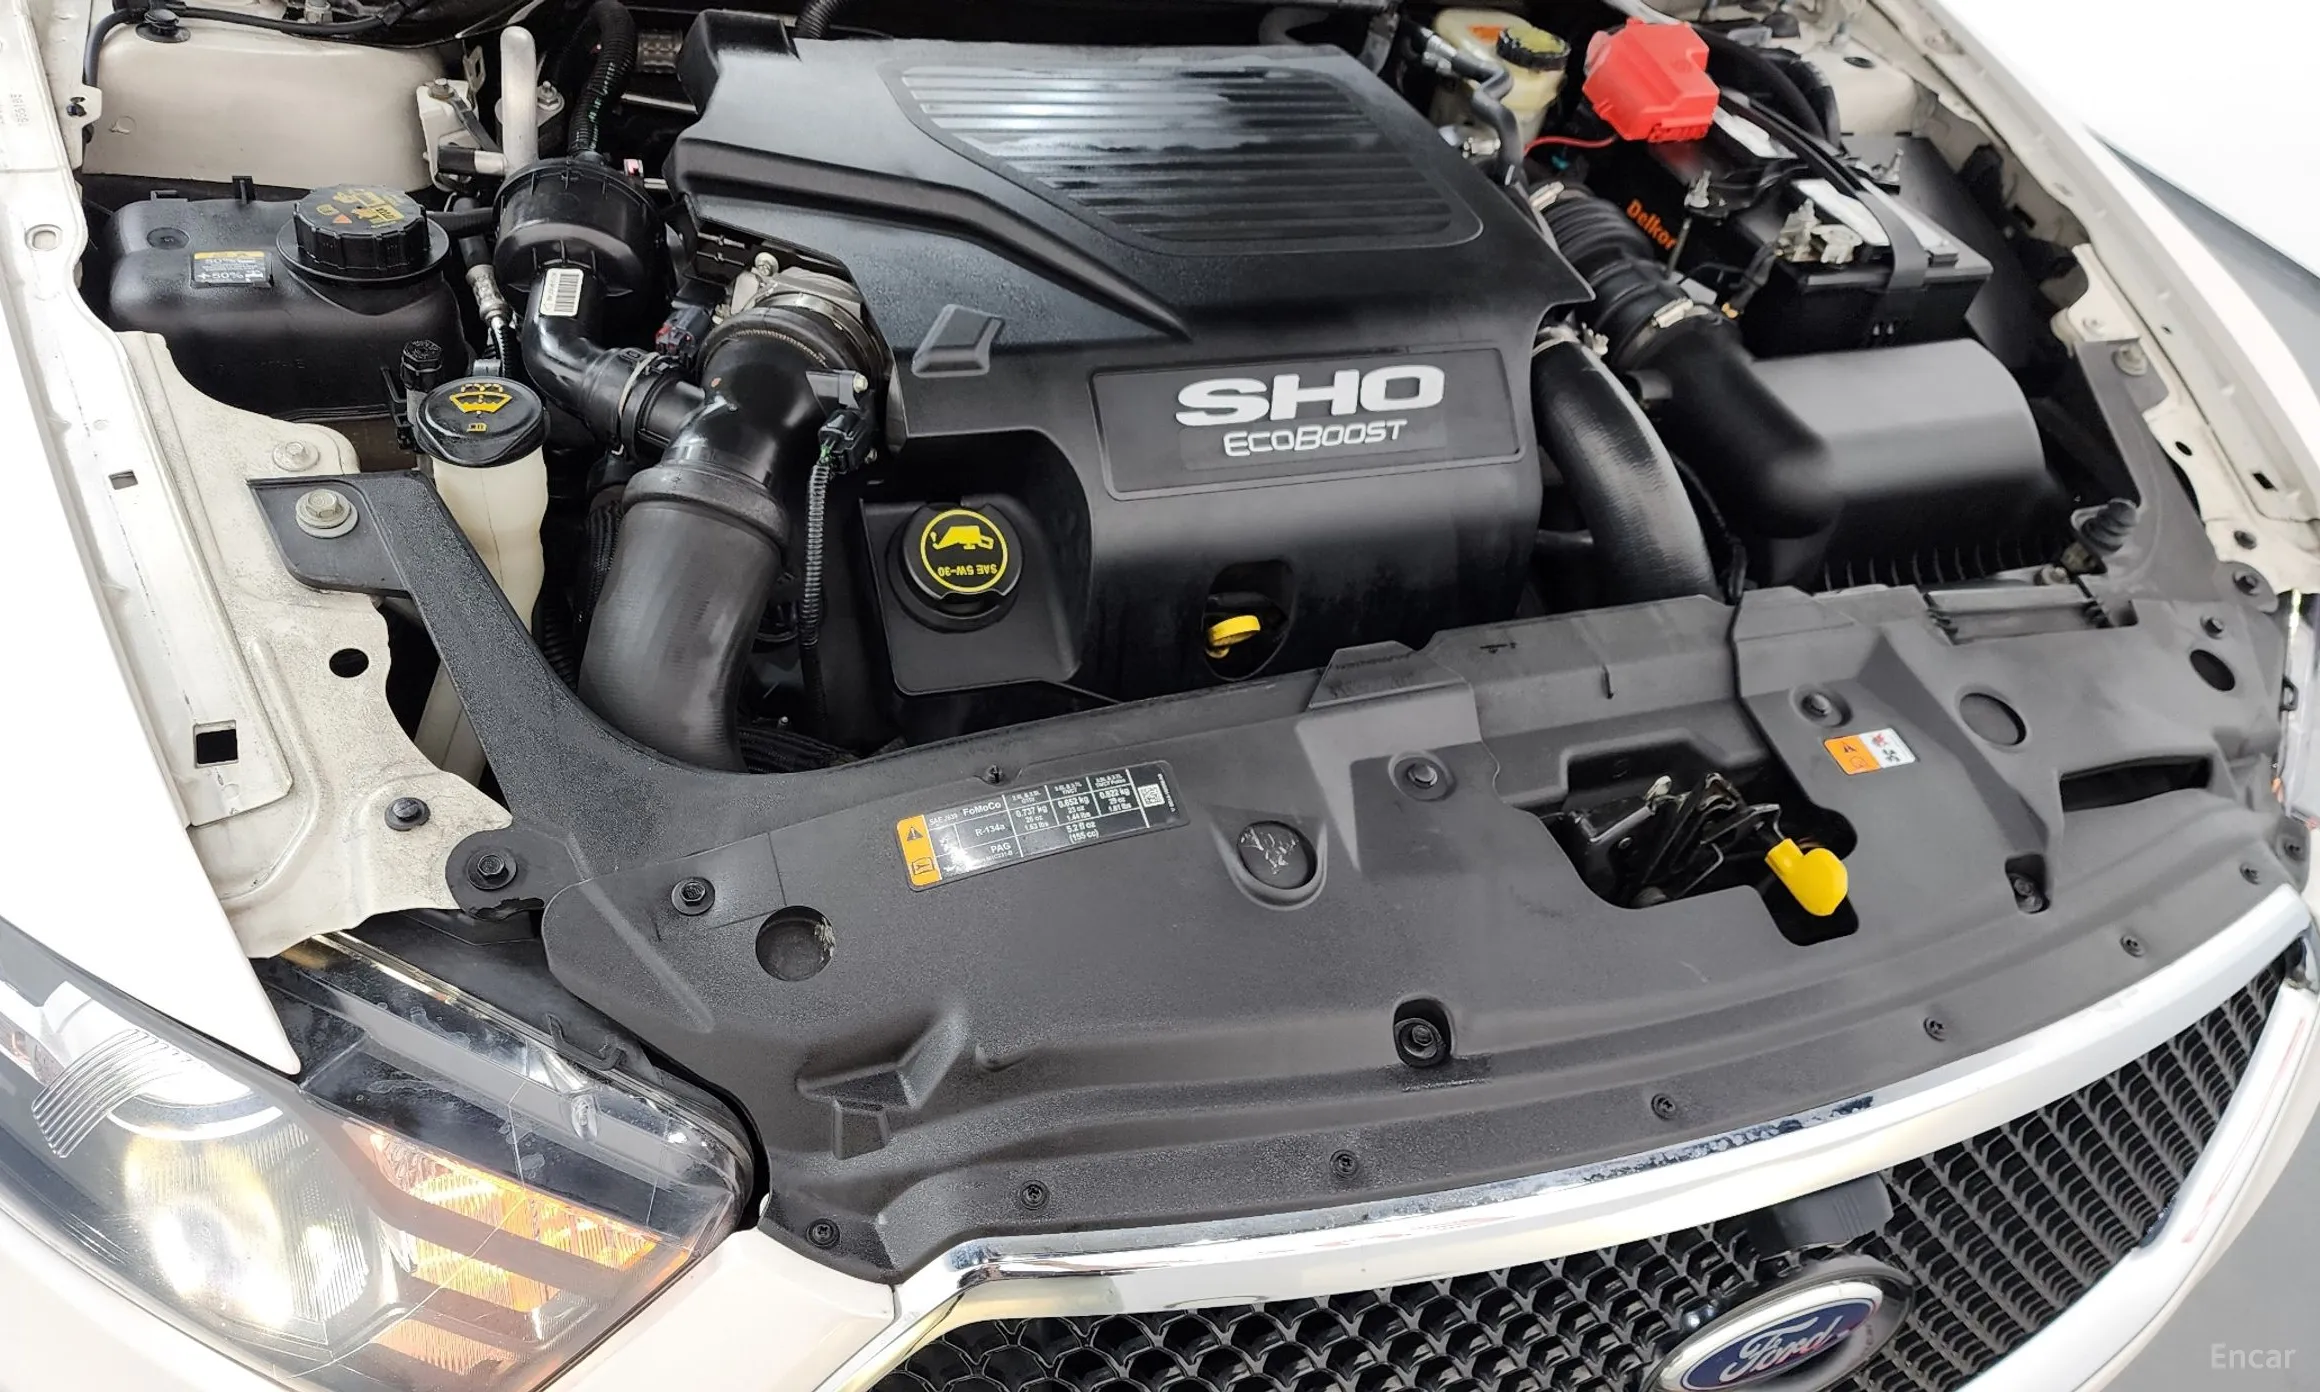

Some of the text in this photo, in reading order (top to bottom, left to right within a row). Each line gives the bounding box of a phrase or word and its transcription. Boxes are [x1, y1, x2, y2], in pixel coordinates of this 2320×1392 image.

[1626, 198, 1676, 250] Delkor
[1176, 364, 1445, 426] SHO
[937, 564, 998, 577] SAE 5W-30
[1120, 788, 1130, 796] kg
[1058, 796, 1090, 808] 0.652 kg
[962, 802, 1002, 816] FoMoCo
[1016, 805, 1048, 818] 0.737 kg
[975, 823, 1006, 837] R-134a
[1066, 824, 1079, 833] 5.2
[1069, 828, 1099, 844] (155 cc)
[990, 842, 1011, 853] PAG
[1719, 1315, 1844, 1383] Ford
